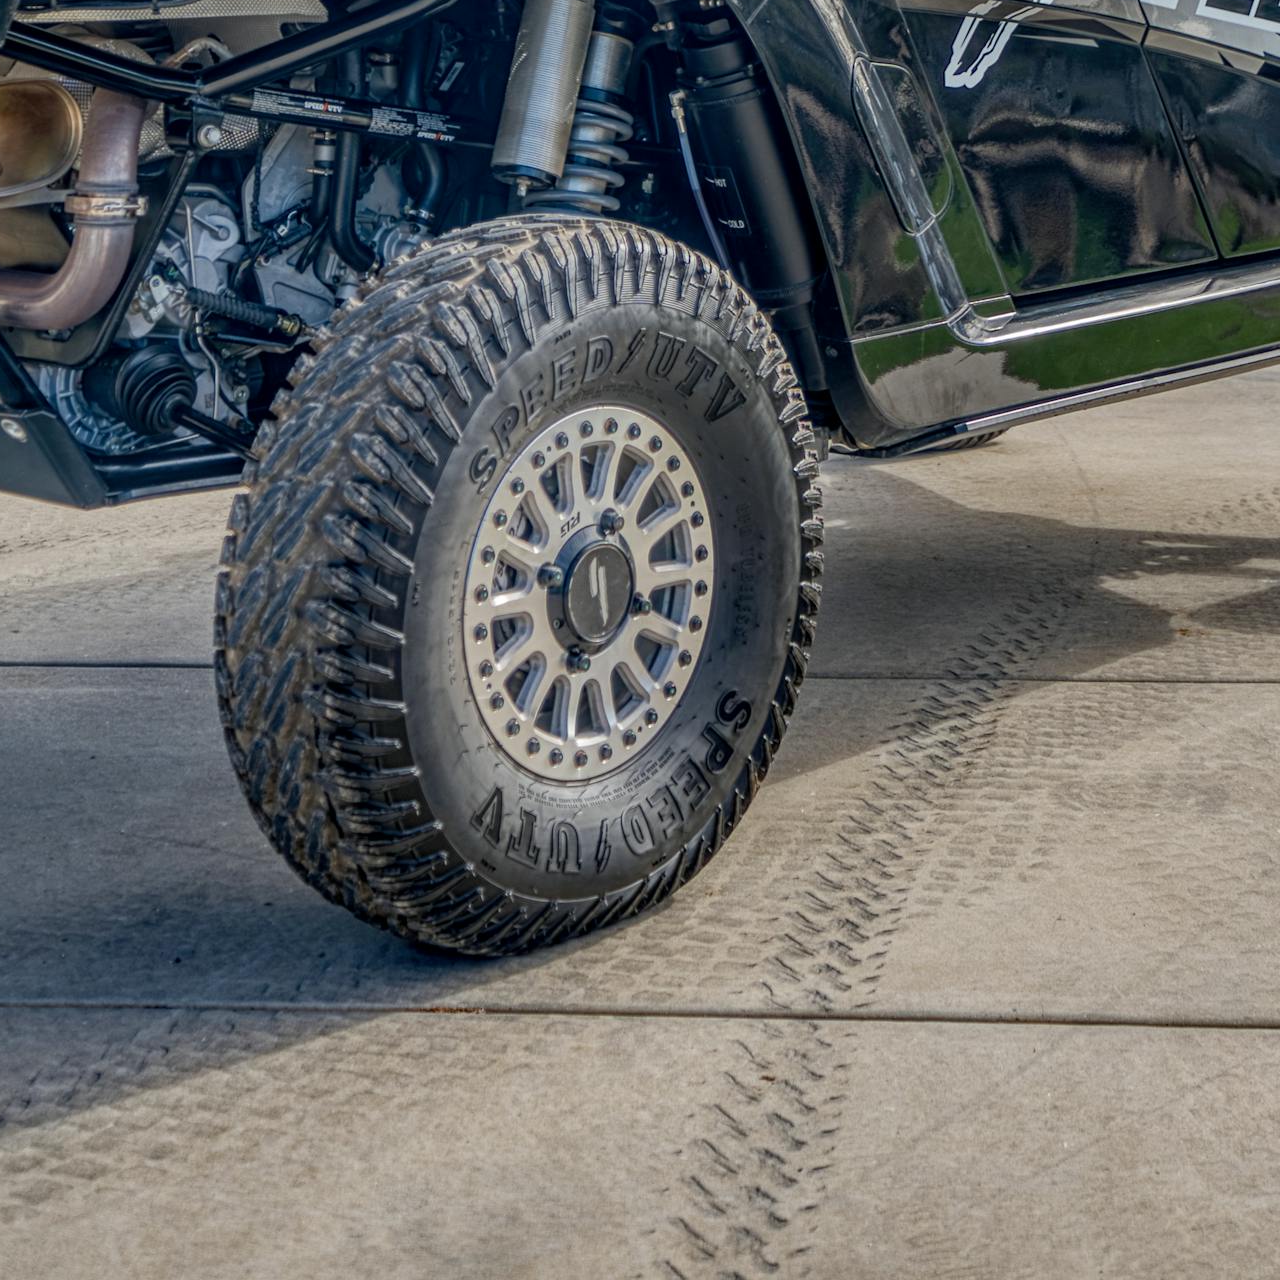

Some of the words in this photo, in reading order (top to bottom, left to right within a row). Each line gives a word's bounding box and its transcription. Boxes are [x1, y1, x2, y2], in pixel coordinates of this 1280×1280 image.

[714, 177, 727, 188] HOT
[728, 219, 745, 229] COLD
[470, 334, 614, 495] SPEED
[646, 330, 747, 422] UTV
[620, 688, 753, 856] SPEED
[470, 786, 581, 874] UTV
